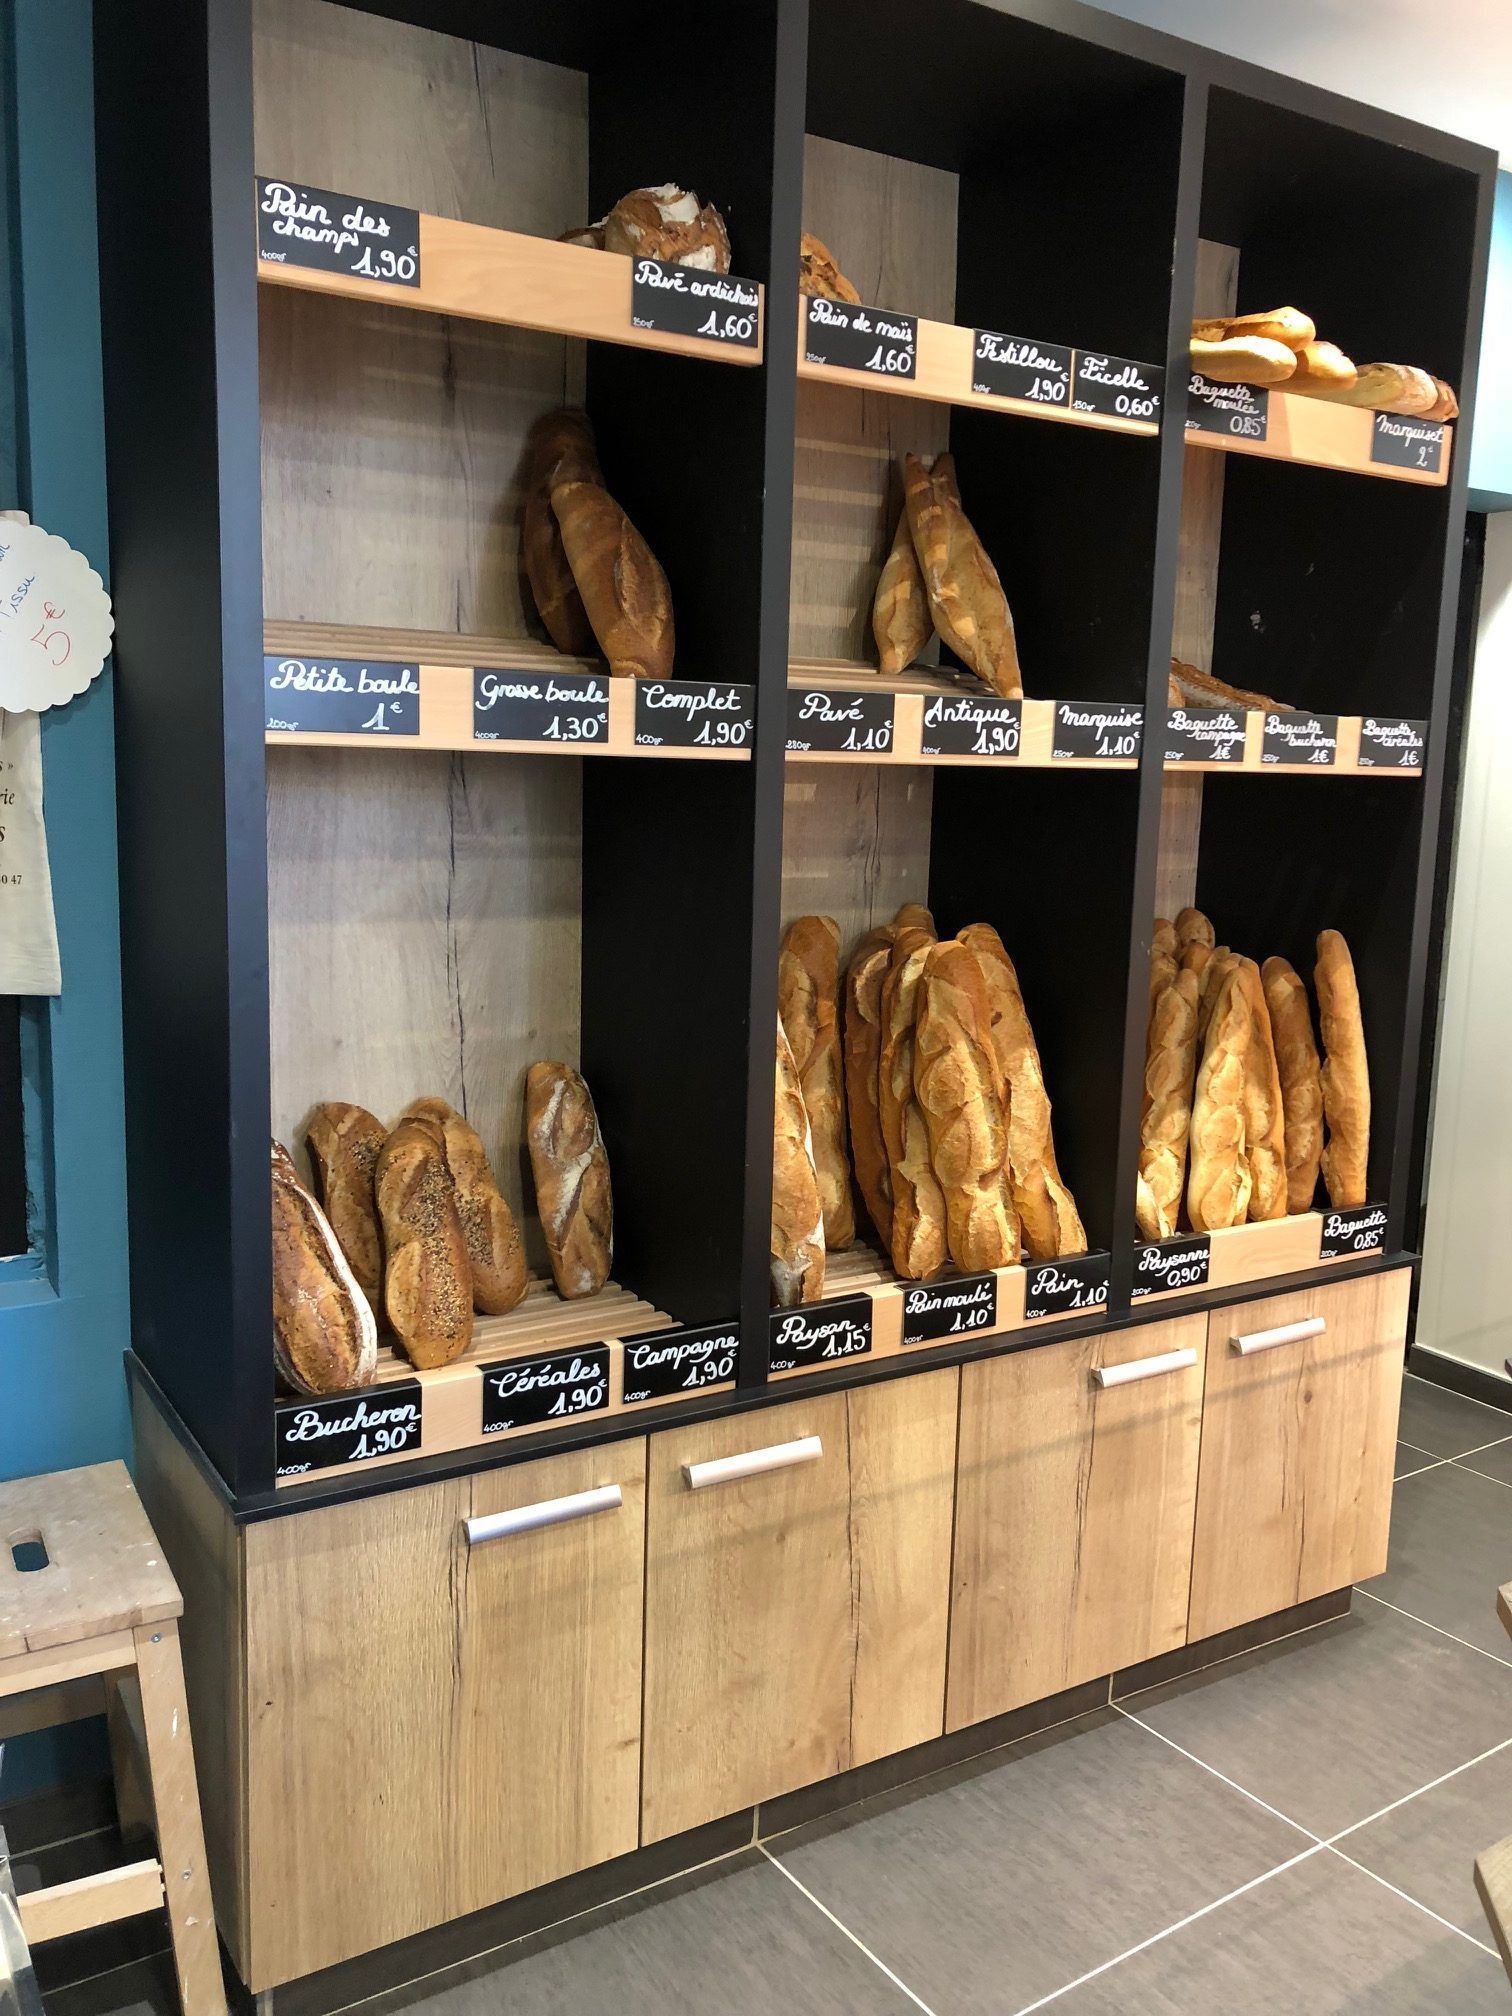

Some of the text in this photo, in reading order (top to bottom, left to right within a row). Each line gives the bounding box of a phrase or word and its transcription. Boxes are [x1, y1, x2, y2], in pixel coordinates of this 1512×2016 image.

[261, 183, 390, 237] Pain des
[273, 218, 360, 254] champs
[634, 260, 759, 307] Pavé ardèchois
[809, 299, 913, 342] Pain de maïs
[1079, 357, 1149, 391] Ficelle
[1188, 375, 1255, 403] Baguette
[270, 661, 420, 696] Petite boule
[474, 674, 609, 711] Grosse boule
[642, 684, 742, 721] Complet
[799, 692, 864, 722] Pavé
[924, 697, 1016, 733] Antique
[1167, 710, 1238, 738] Baguette
[1265, 714, 1324, 741] Baguette
[1362, 719, 1416, 743] Baguette
[1209, 745, 1231, 760] 1€
[1307, 748, 1329, 763] 1€
[1398, 750, 1419, 766] 1€
[1324, 1210, 1387, 1239] Baguette
[1138, 1246, 1210, 1277] Paysanne
[1031, 1267, 1085, 1296] Pain
[906, 1282, 993, 1315] Pain moulé
[776, 1315, 857, 1351] Paysan
[627, 1333, 740, 1371] Campagne
[489, 1357, 602, 1398] Céréales
[624, 1388, 652, 1403] 400gr
[285, 1400, 421, 1442] Bucheron
[483, 1419, 514, 1433] 400gr
[276, 1461, 311, 1475] 400gr
